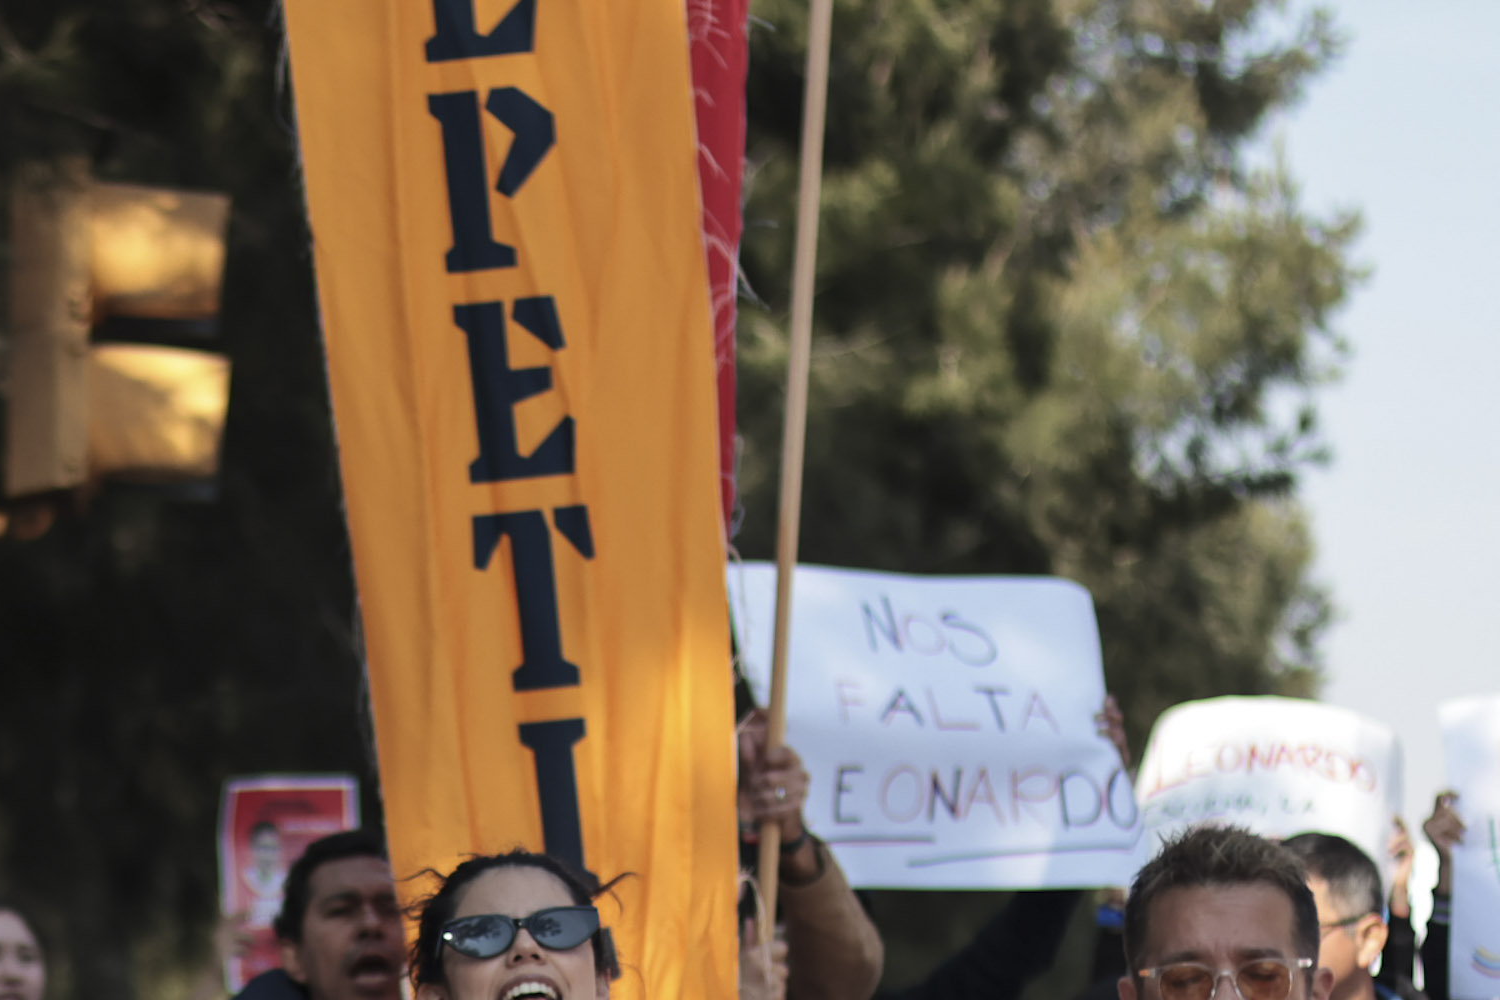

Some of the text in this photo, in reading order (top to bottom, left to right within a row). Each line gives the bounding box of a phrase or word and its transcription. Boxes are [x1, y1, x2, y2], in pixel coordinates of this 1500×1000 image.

[861, 594, 998, 667] NOS
[836, 680, 1061, 733] FALTA
[832, 763, 1140, 831] EONARDO
[1147, 744, 1378, 793] LEONARDO
